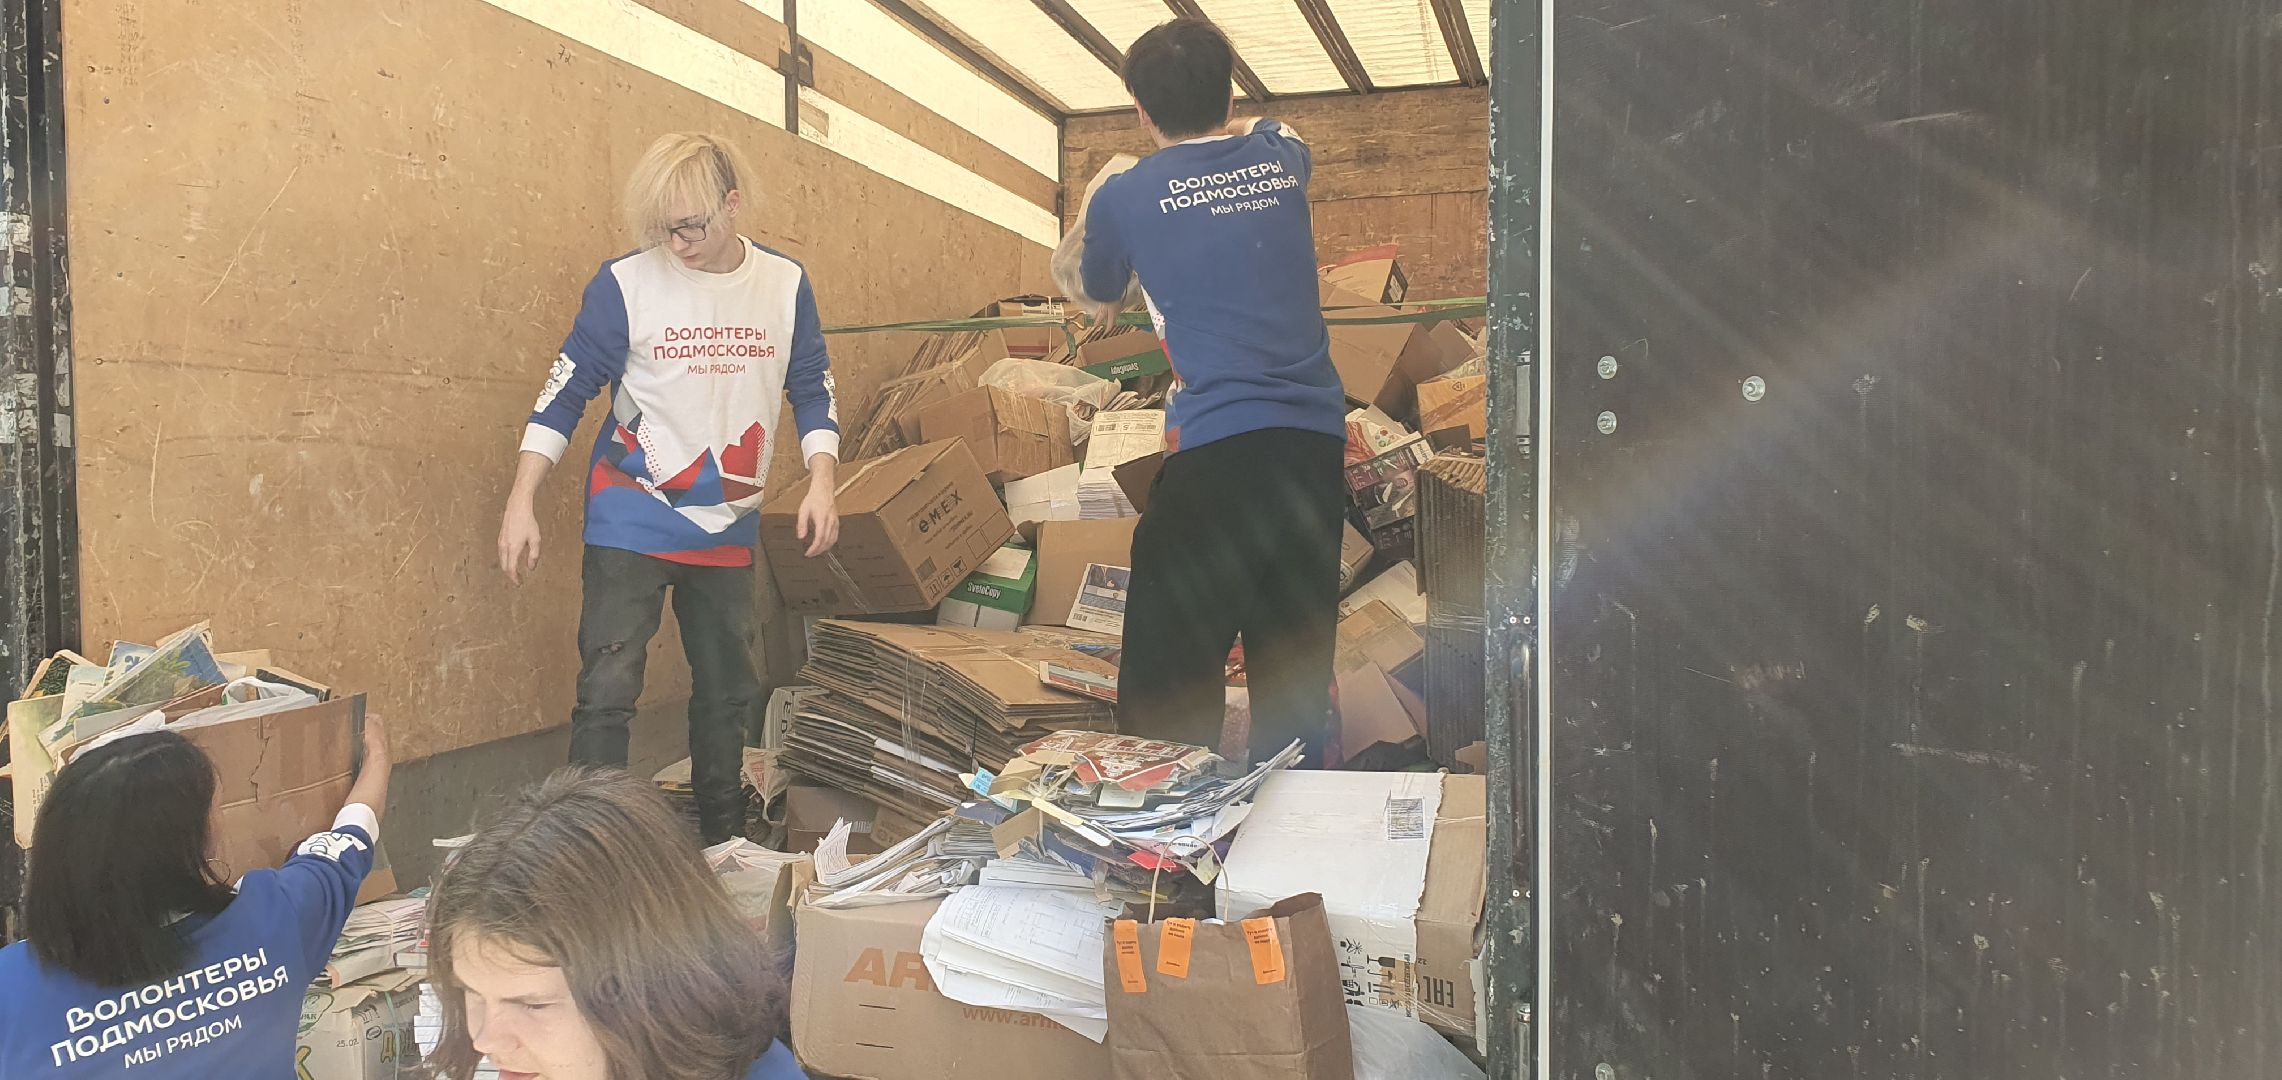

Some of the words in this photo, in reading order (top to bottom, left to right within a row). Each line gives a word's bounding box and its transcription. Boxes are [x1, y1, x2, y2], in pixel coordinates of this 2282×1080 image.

[1159, 175, 1299, 214] ПОДМОСКОВЬЯ
[1168, 160, 1284, 195] ВОЛОНТЕРЫ
[1210, 203, 1234, 216] МЫ
[1235, 196, 1280, 212] РЯДОМ
[664, 326, 767, 342] ВОЛОНТЕРЫ
[653, 344, 775, 361] ПОДМОСКОВЬЯ
[687, 364, 708, 375] МЫ
[709, 363, 746, 375] РЯДОМ
[967, 581, 1001, 600] SvetoCopy
[843, 947, 940, 993] AR
[65, 947, 268, 1034] ВОЛОНТЕРЫ
[50, 965, 289, 1067] ПОДМОСКОВЬЯ
[124, 1042, 163, 1069] МЫ
[166, 1014, 243, 1054] РЯДОМ
